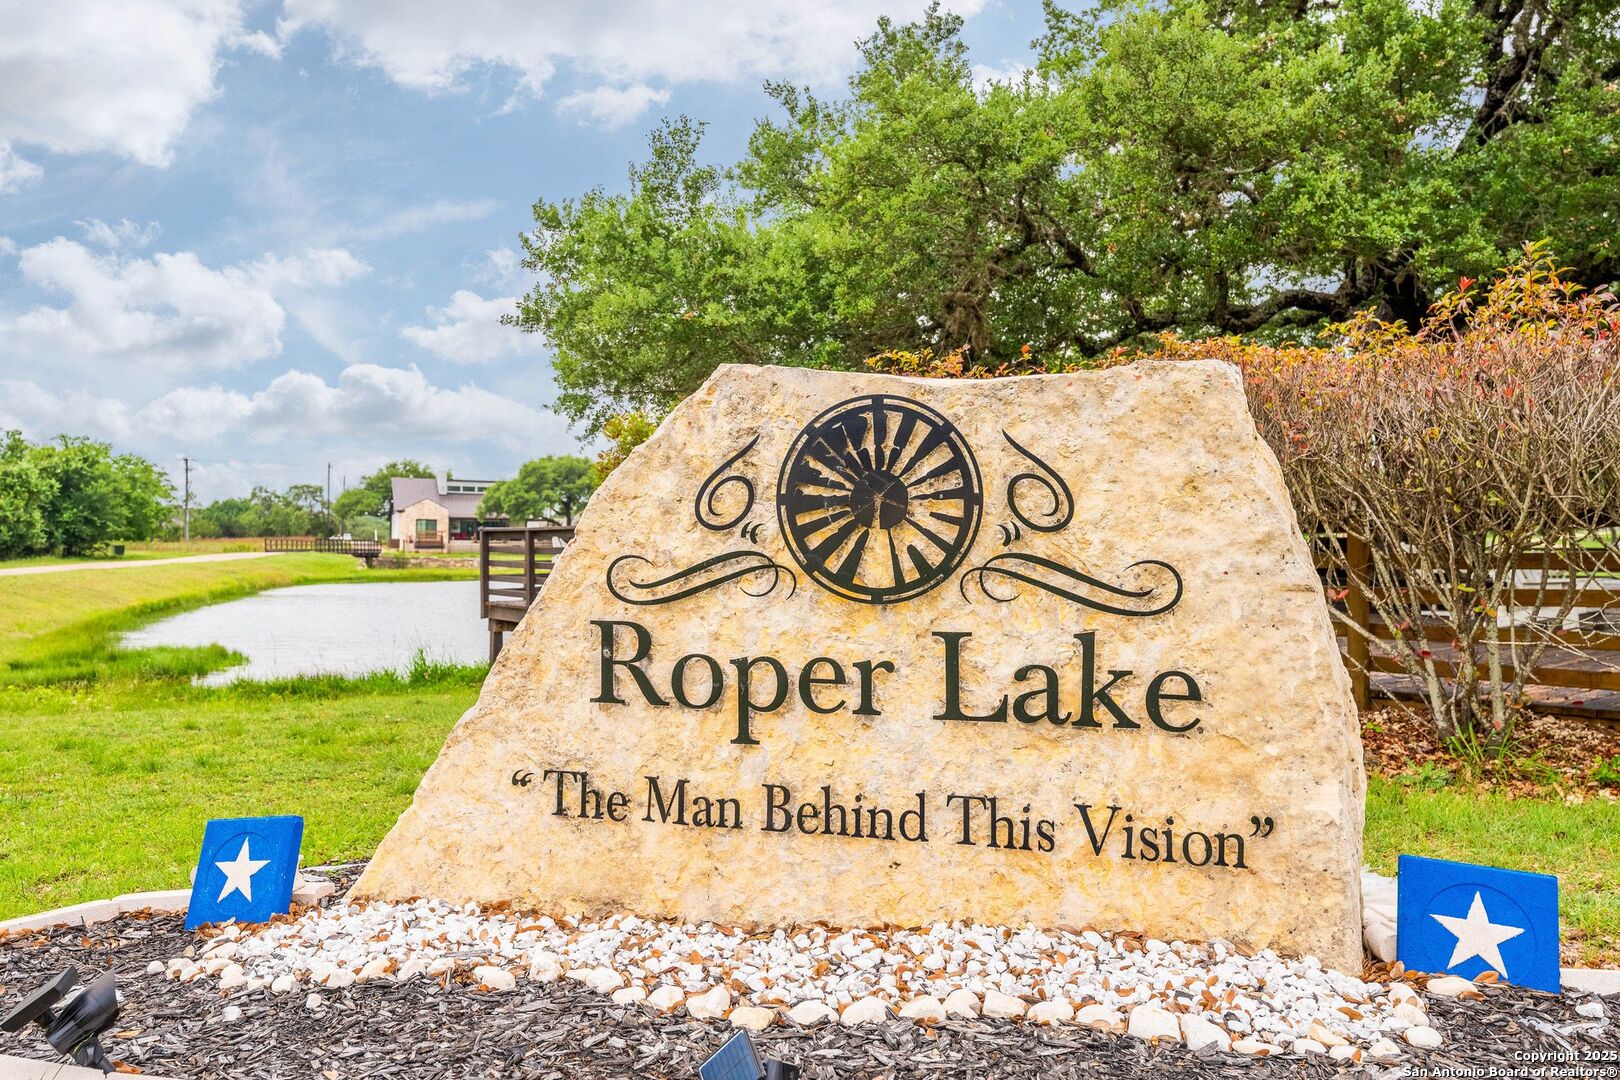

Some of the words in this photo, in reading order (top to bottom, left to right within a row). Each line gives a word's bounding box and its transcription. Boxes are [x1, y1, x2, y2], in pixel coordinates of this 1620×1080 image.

[590, 620, 895, 744] Roper
[932, 630, 1202, 732] Lake
[511, 769, 630, 822] “The
[641, 775, 744, 829] Man
[761, 784, 929, 842] Behind
[946, 793, 1056, 852] This
[1074, 803, 1274, 869] Vision”
